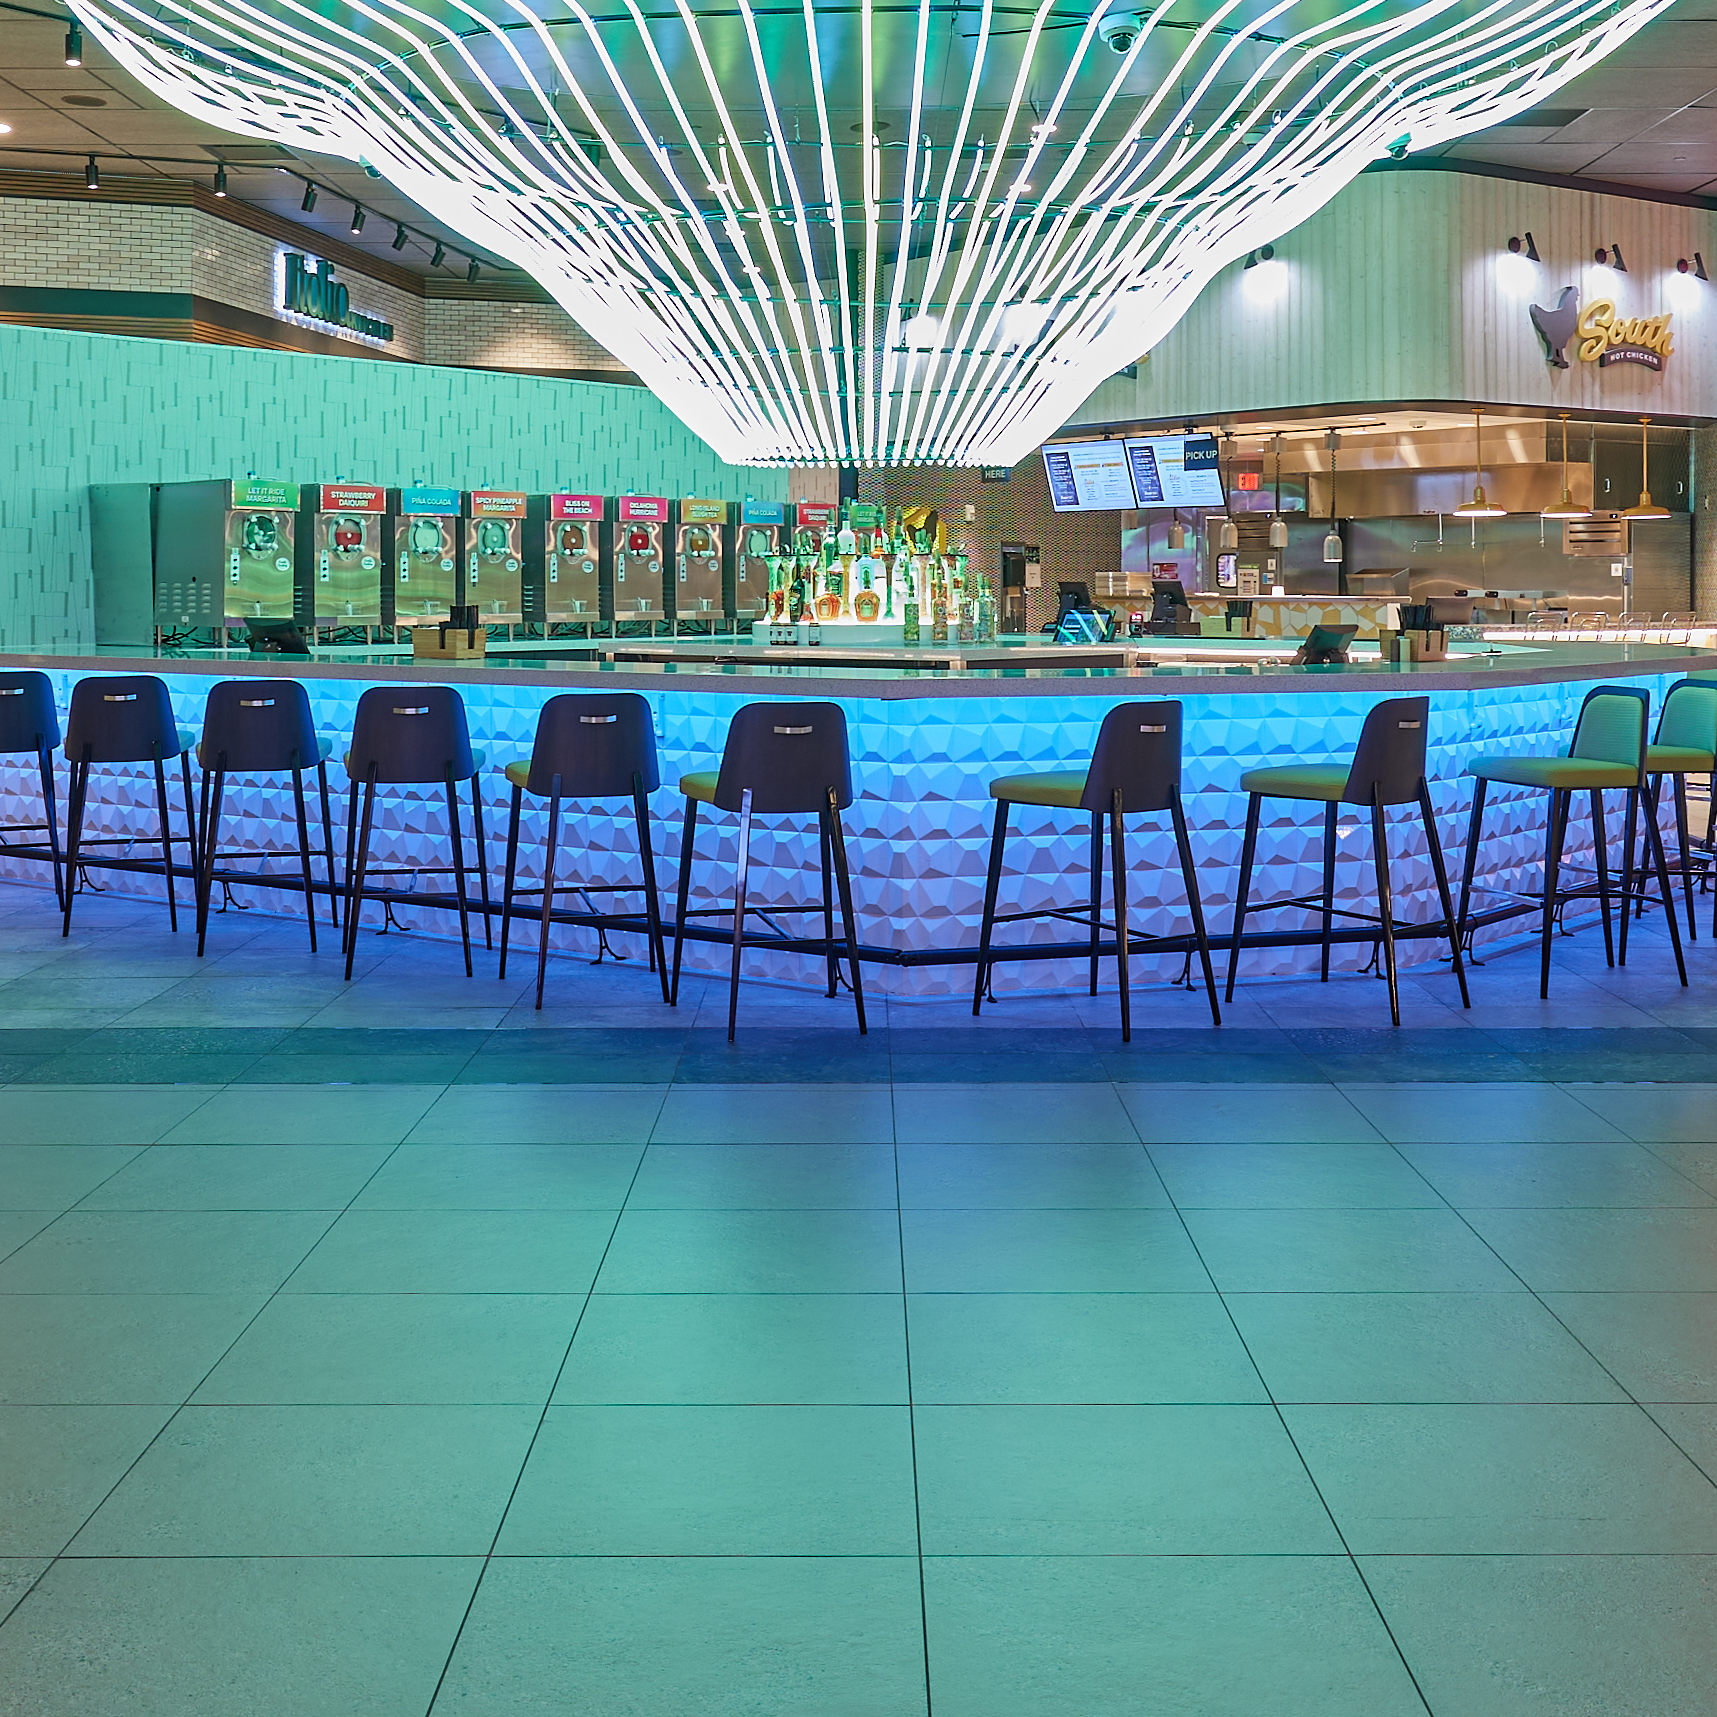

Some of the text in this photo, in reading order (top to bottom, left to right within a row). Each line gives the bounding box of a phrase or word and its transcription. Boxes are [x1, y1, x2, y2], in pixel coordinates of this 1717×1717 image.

[1578, 297, 1675, 362] South
[1610, 351, 1659, 365] HOT CHICKEN
[1185, 449, 1218, 461] PICK UP
[985, 469, 1007, 479] HERE
[247, 487, 286, 496] LET IT RIDE
[331, 491, 377, 500] STRAWBERRY
[245, 495, 287, 504] MARGARITA
[338, 499, 369, 507] DAIQUIRI
[426, 498, 452, 506] COLADA
